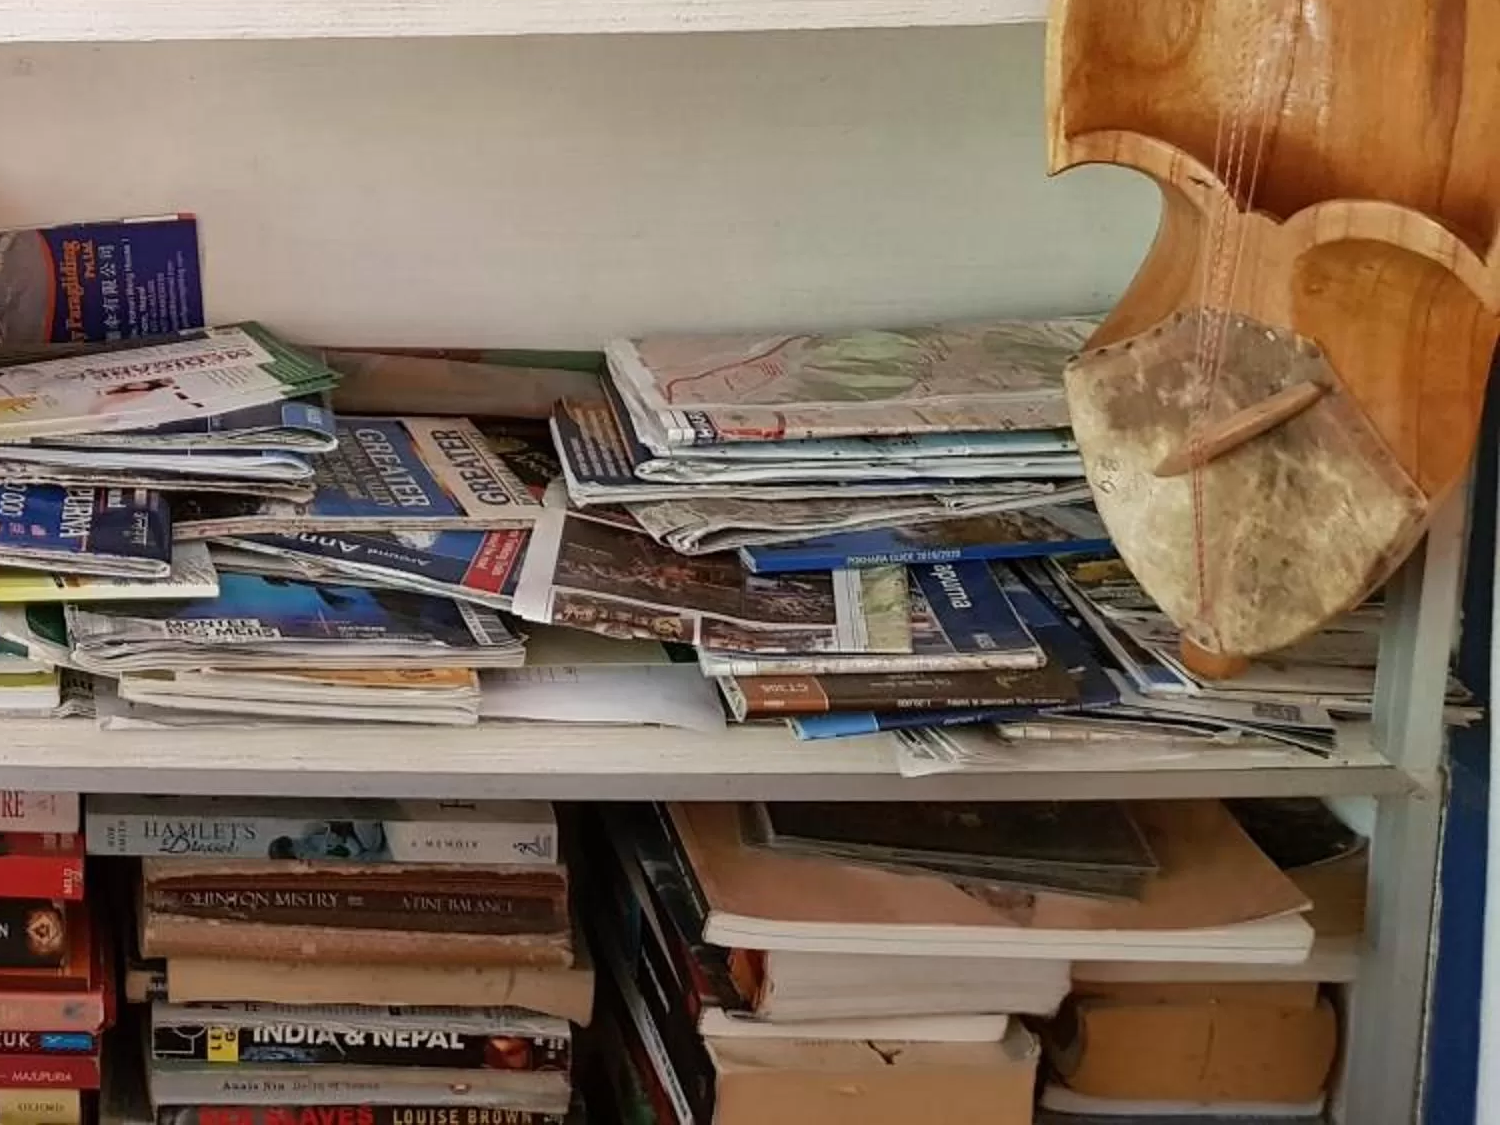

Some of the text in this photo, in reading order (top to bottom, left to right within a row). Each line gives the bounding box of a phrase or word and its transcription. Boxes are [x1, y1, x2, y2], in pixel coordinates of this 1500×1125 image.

[62, 239, 86, 337] Paragliding
[354, 428, 433, 507] GREATER
[430, 429, 512, 507] GREATER
[424, 839, 481, 849] MEMOIR
[274, 890, 340, 909] MISTRY
[252, 1025, 466, 1050] INDIA NEPAL
[392, 1109, 534, 1125] LOUISE BROWN
